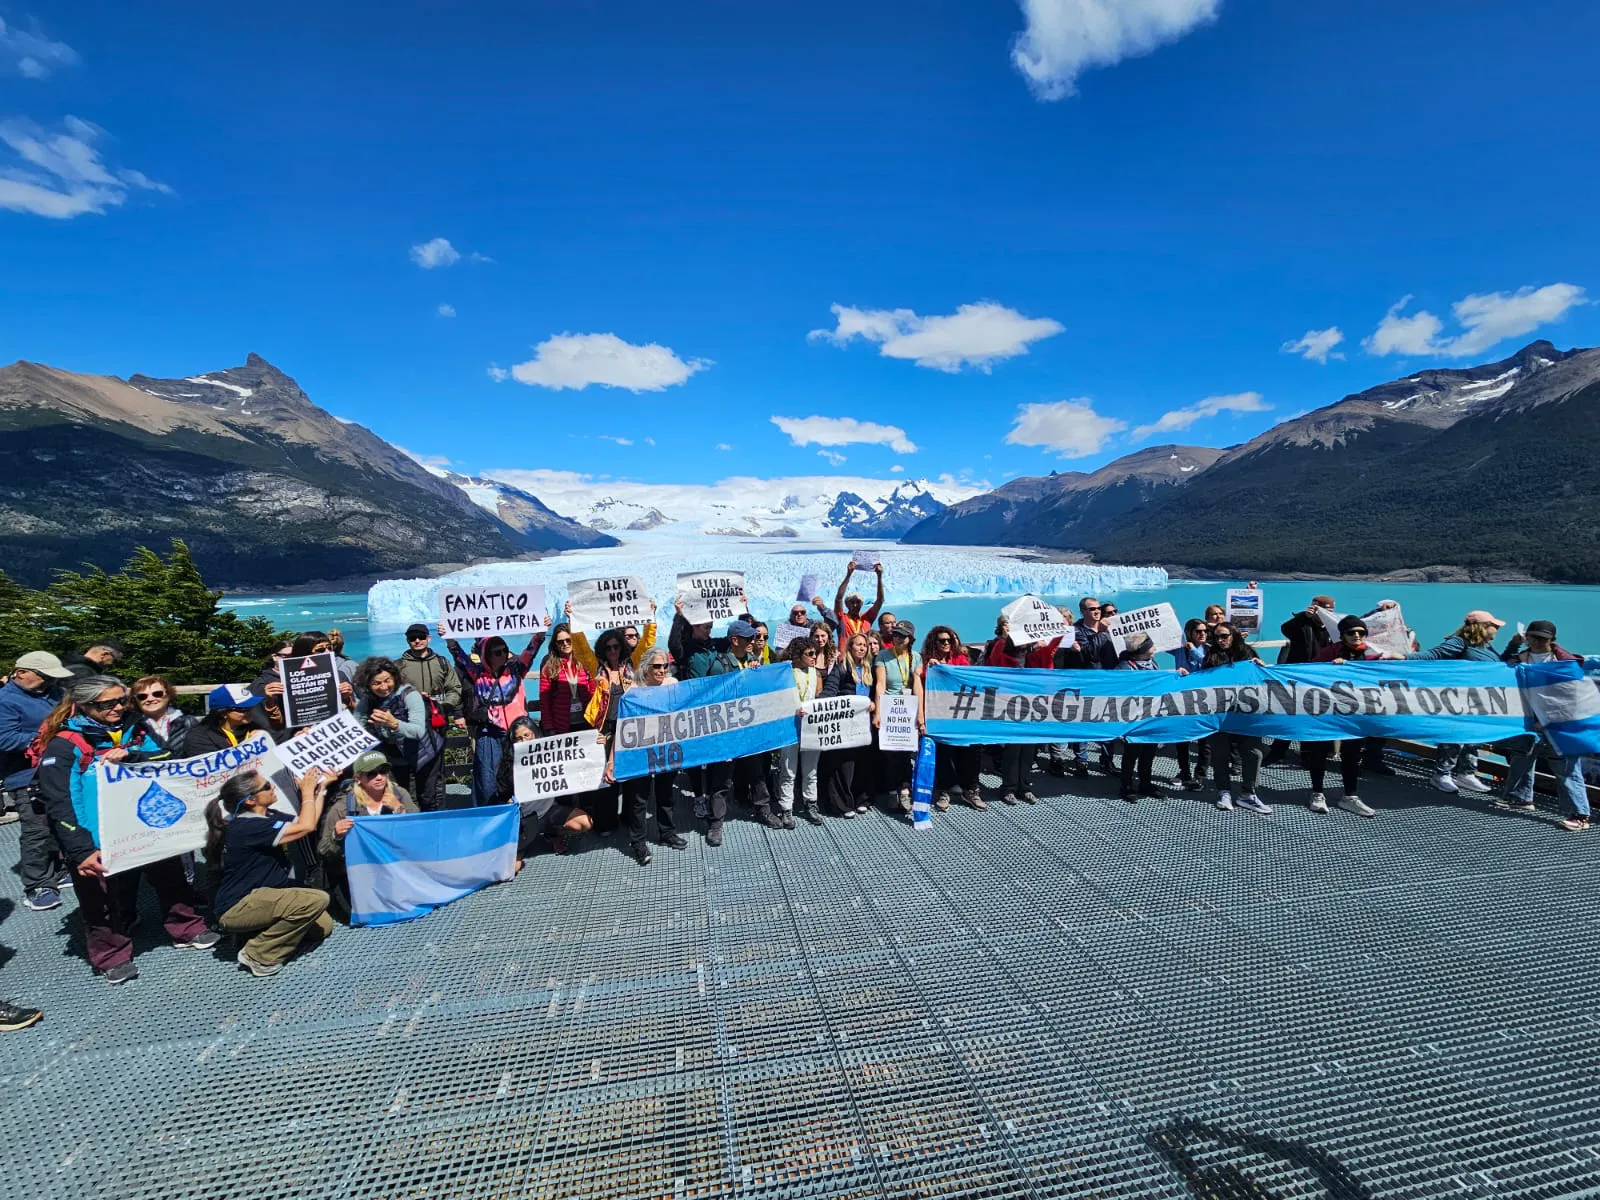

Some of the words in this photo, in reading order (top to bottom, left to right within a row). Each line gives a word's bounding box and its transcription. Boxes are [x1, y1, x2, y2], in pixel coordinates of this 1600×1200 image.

[598, 581, 610, 591] LA
[612, 579, 628, 590] LEY
[692, 579, 702, 588] LA
[704, 579, 718, 588] LEY
[720, 579, 730, 588] DE
[609, 592, 623, 602] NO
[626, 590, 638, 601] SE
[707, 599, 718, 609] NO
[720, 598, 730, 608] SE
[610, 605, 639, 616] TOCA
[709, 609, 733, 619] TOCA
[1040, 612, 1049, 621] DE
[1120, 615, 1131, 624] LA
[1132, 611, 1146, 622] LEY
[1148, 608, 1160, 618] DE
[447, 616, 490, 632] VENDE
[497, 613, 540, 630] PATRIA
[1112, 619, 1161, 636] GLACIARES
[290, 672, 331, 683] GLACIARES
[292, 686, 325, 695] PELIGRO
[813, 702, 823, 712] LA
[825, 700, 838, 711] LEY
[841, 699, 851, 709] DE
[893, 698, 904, 706] SIN
[807, 709, 855, 724] GLACIARES
[890, 706, 907, 714] AGUA
[887, 715, 896, 723] NO
[817, 724, 829, 735] NO
[831, 722, 841, 733] SE
[886, 725, 911, 734] FUTURO
[286, 741, 308, 755] LA
[304, 728, 328, 746] LEY
[328, 718, 348, 733] DE
[818, 735, 841, 746] TOCA
[291, 726, 364, 769] GLACIARES
[528, 744, 541, 753] LA
[544, 739, 562, 751] LEY
[565, 736, 579, 748] DE
[322, 754, 342, 769] SE
[338, 736, 375, 759] TOCA
[521, 748, 585, 766] GLACIARES
[647, 743, 683, 774] NO
[104, 765, 131, 783] LA
[532, 767, 548, 780] NO
[551, 764, 564, 776] SE
[535, 778, 568, 793] TOCA
